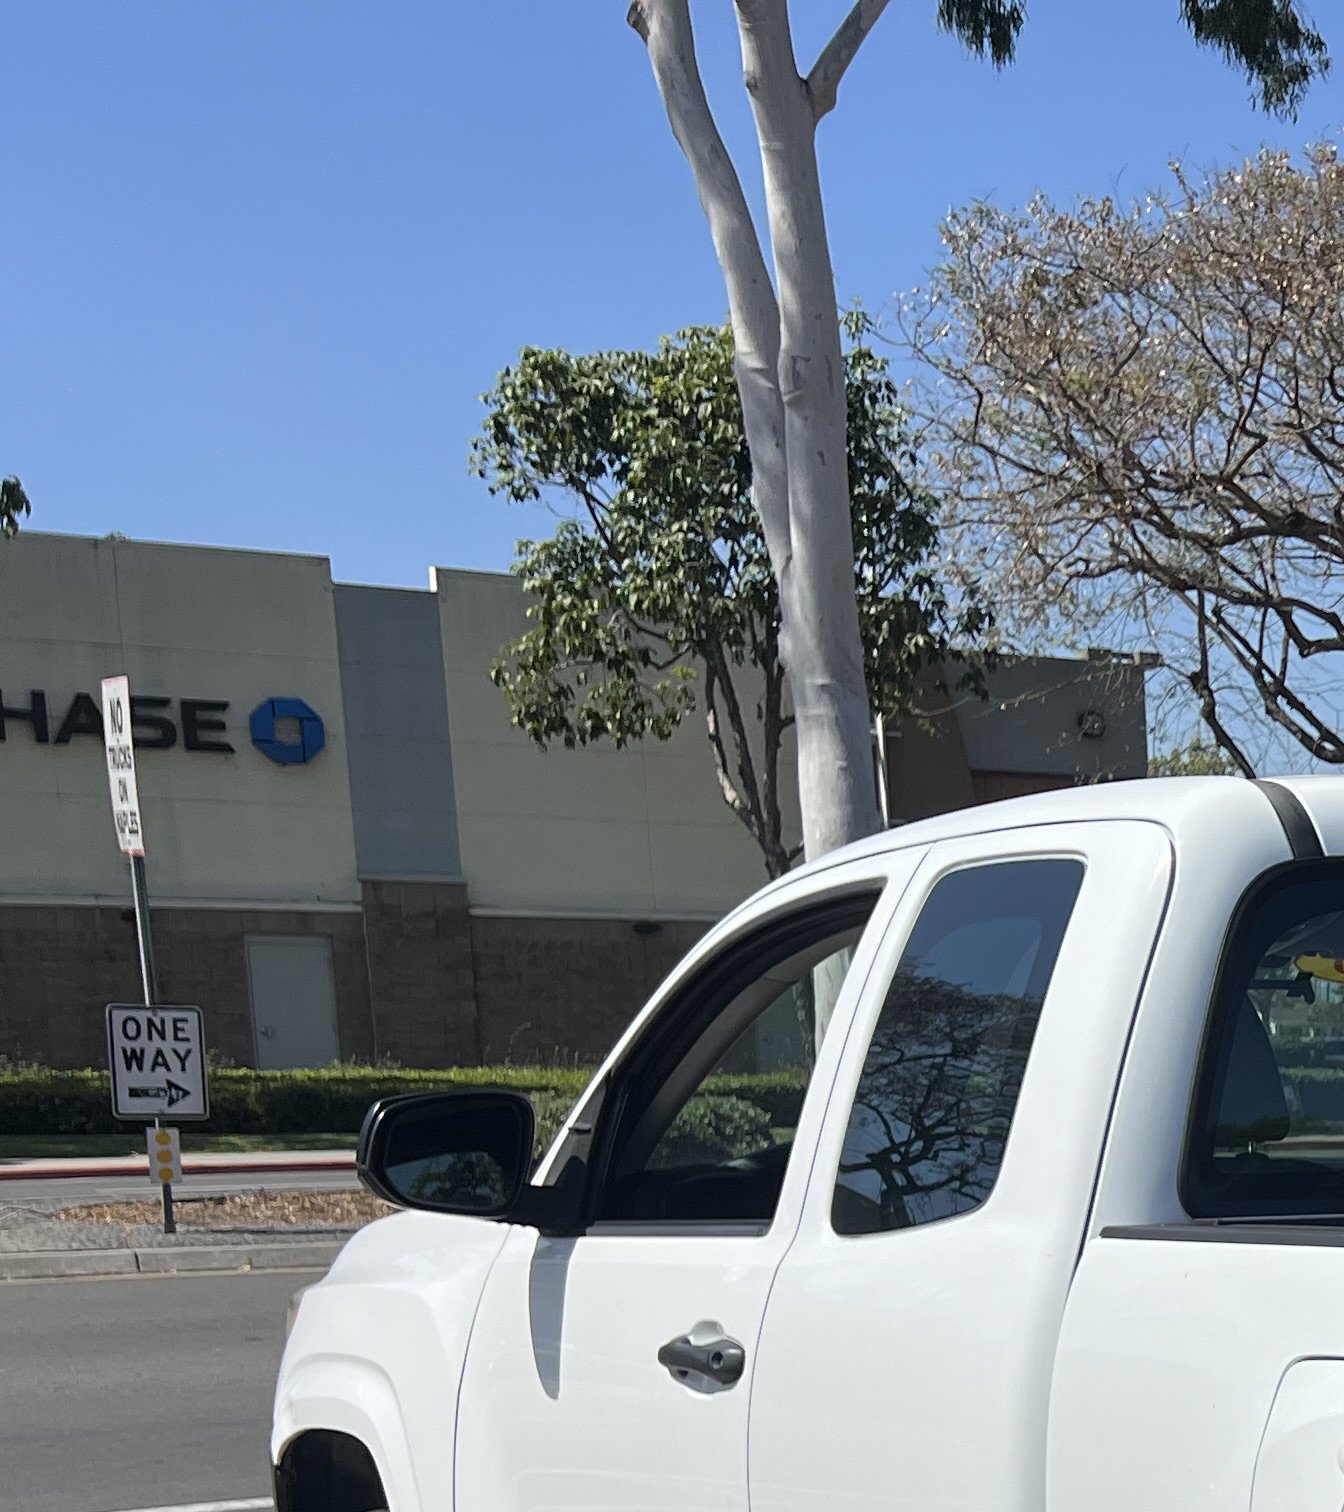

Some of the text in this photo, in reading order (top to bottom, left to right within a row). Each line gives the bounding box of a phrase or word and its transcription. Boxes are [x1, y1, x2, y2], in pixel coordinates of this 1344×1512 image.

[109, 696, 123, 735] NO
[122, 1015, 191, 1042] ONE
[121, 1046, 192, 1073] WAY
